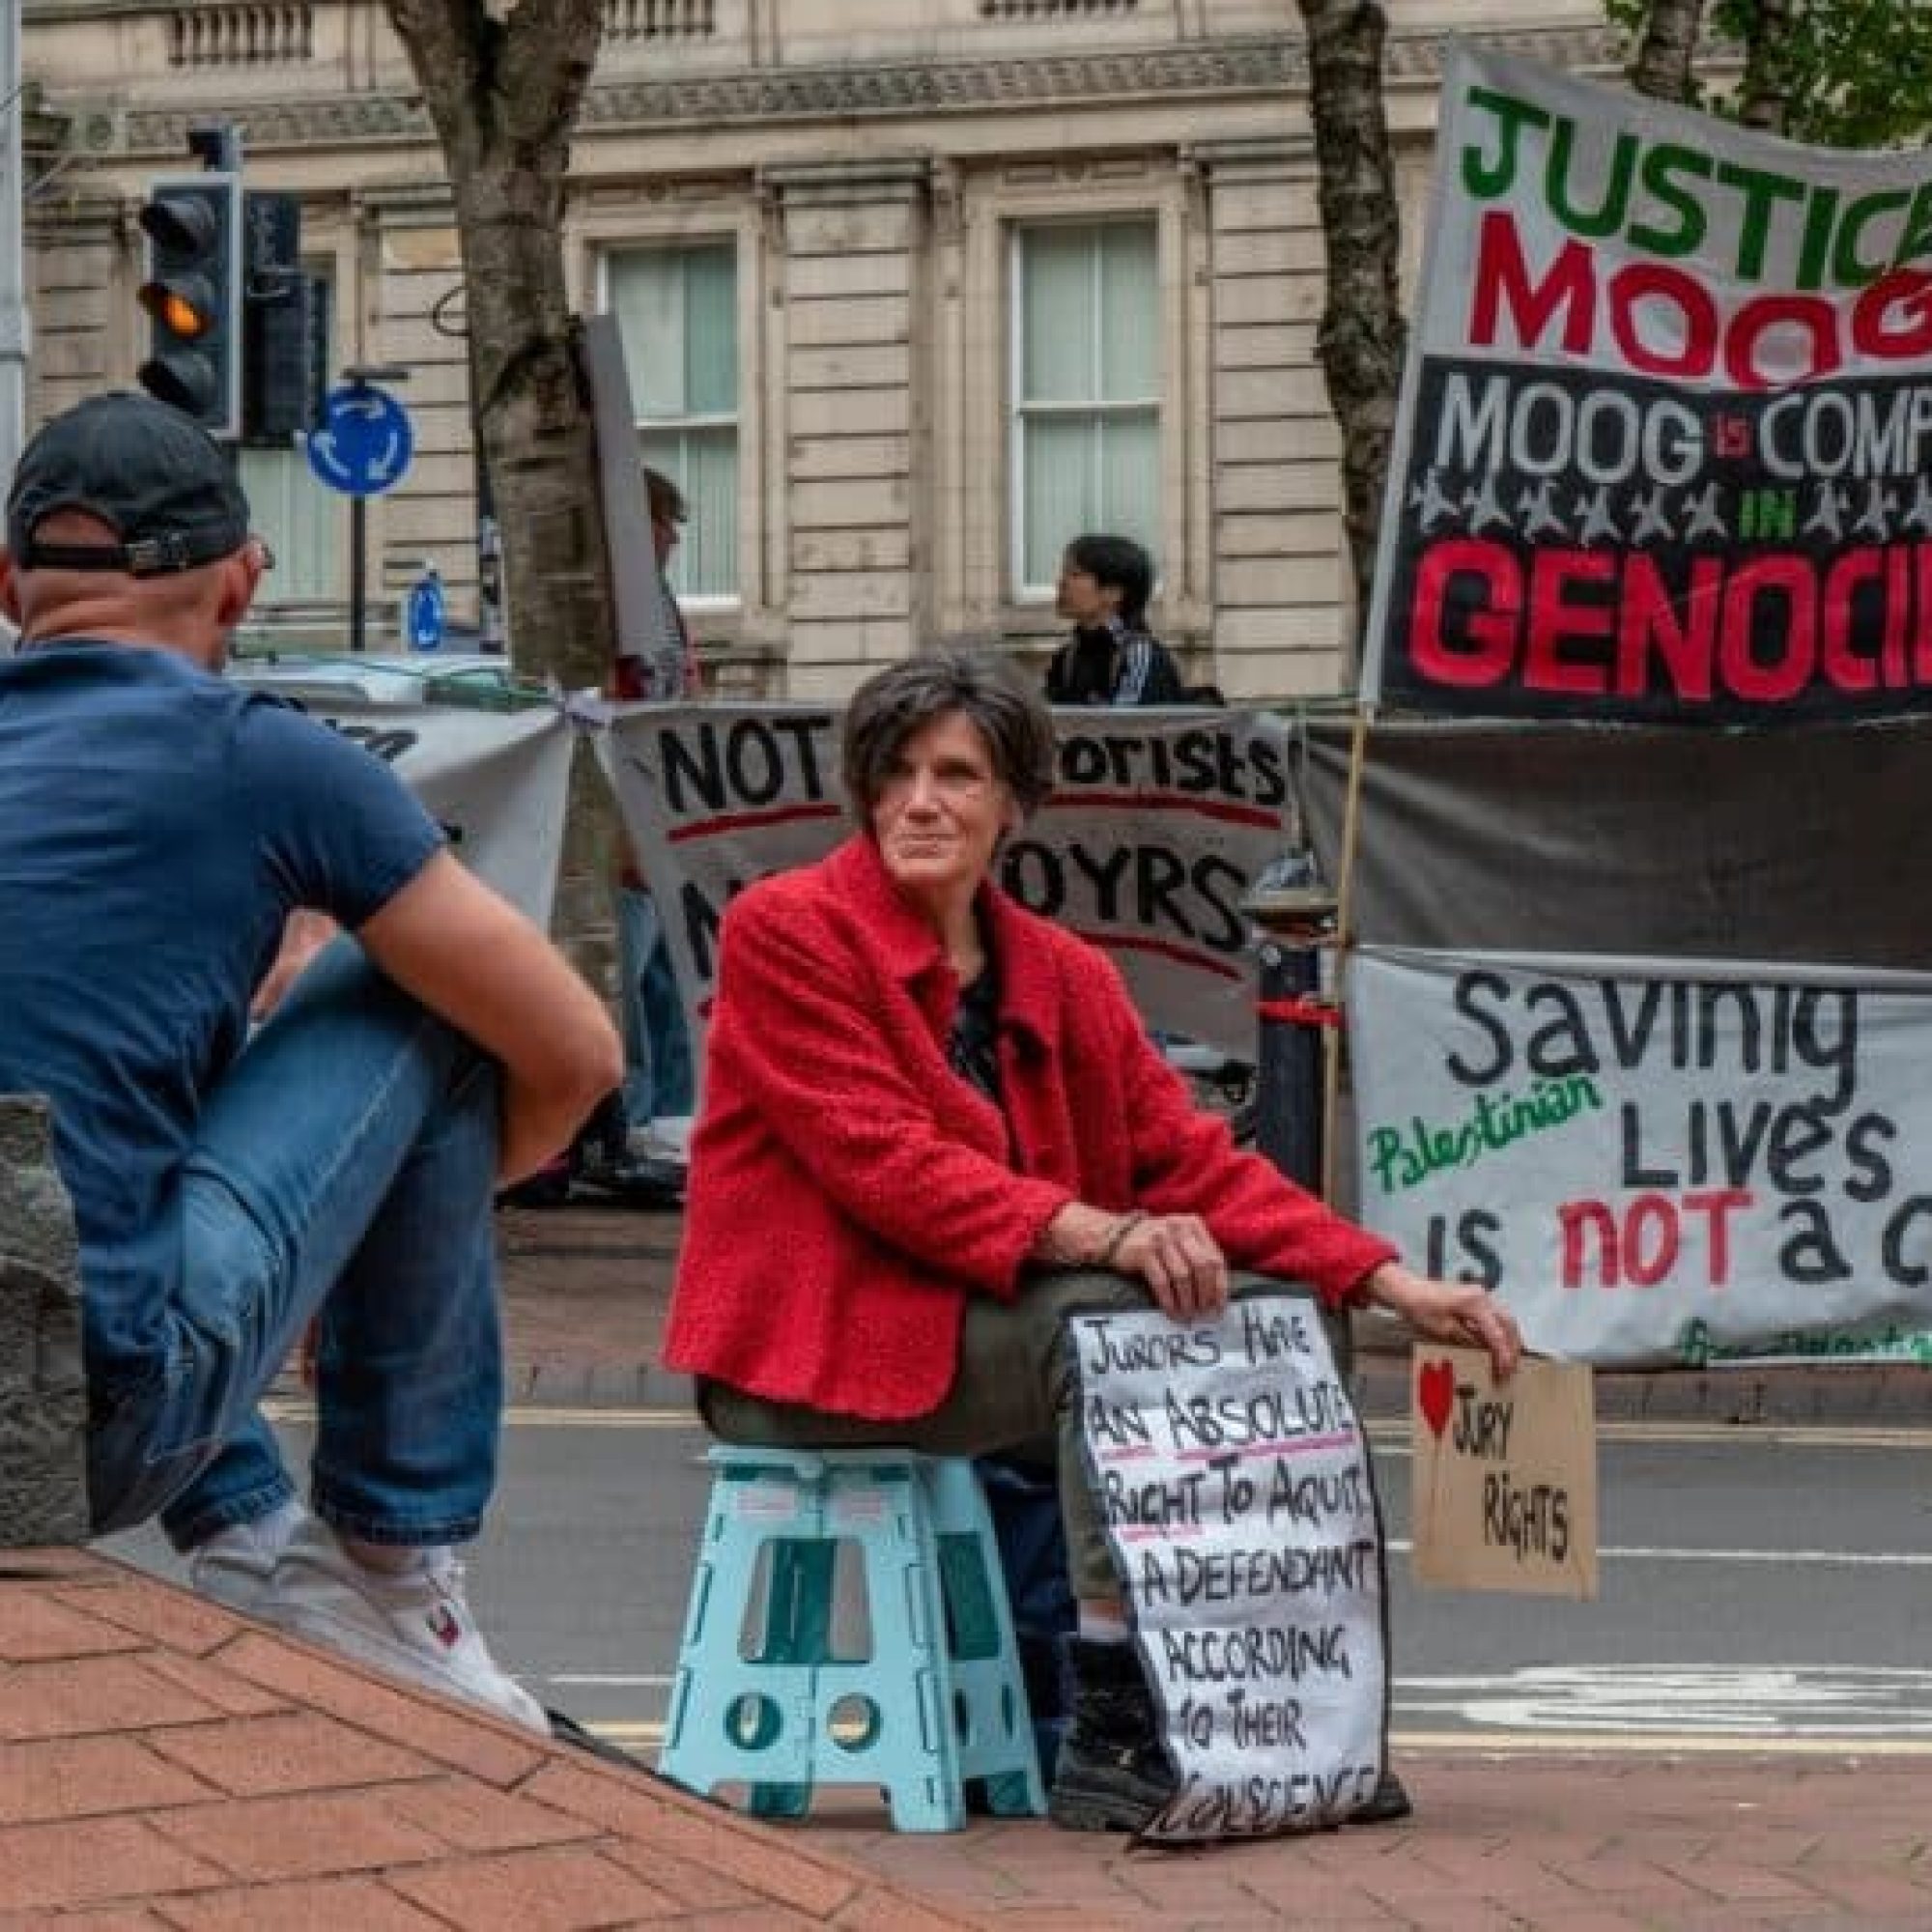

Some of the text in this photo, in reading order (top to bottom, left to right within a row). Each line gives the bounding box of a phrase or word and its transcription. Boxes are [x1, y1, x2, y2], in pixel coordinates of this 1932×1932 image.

[1469, 209, 1932, 392] MOOG
[1434, 373, 1704, 483] MOOG
[1714, 413, 1753, 459] IS
[1740, 490, 1797, 539] IN
[1408, 537, 1932, 701] GENOCI
[659, 716, 1286, 812] NOT orists
[1004, 839, 1248, 951] OYRS
[1367, 1072, 1603, 1194] Palestinian
[1088, 1395, 1152, 1443] AN
[1453, 1383, 1515, 1461] JURY
[1105, 1469, 1206, 1525] RIGHT
[1142, 1540, 1375, 1607] A DEFENDANT
[1162, 1624, 1351, 1682] ACCORDING
[1227, 1688, 1306, 1750] THEIR
